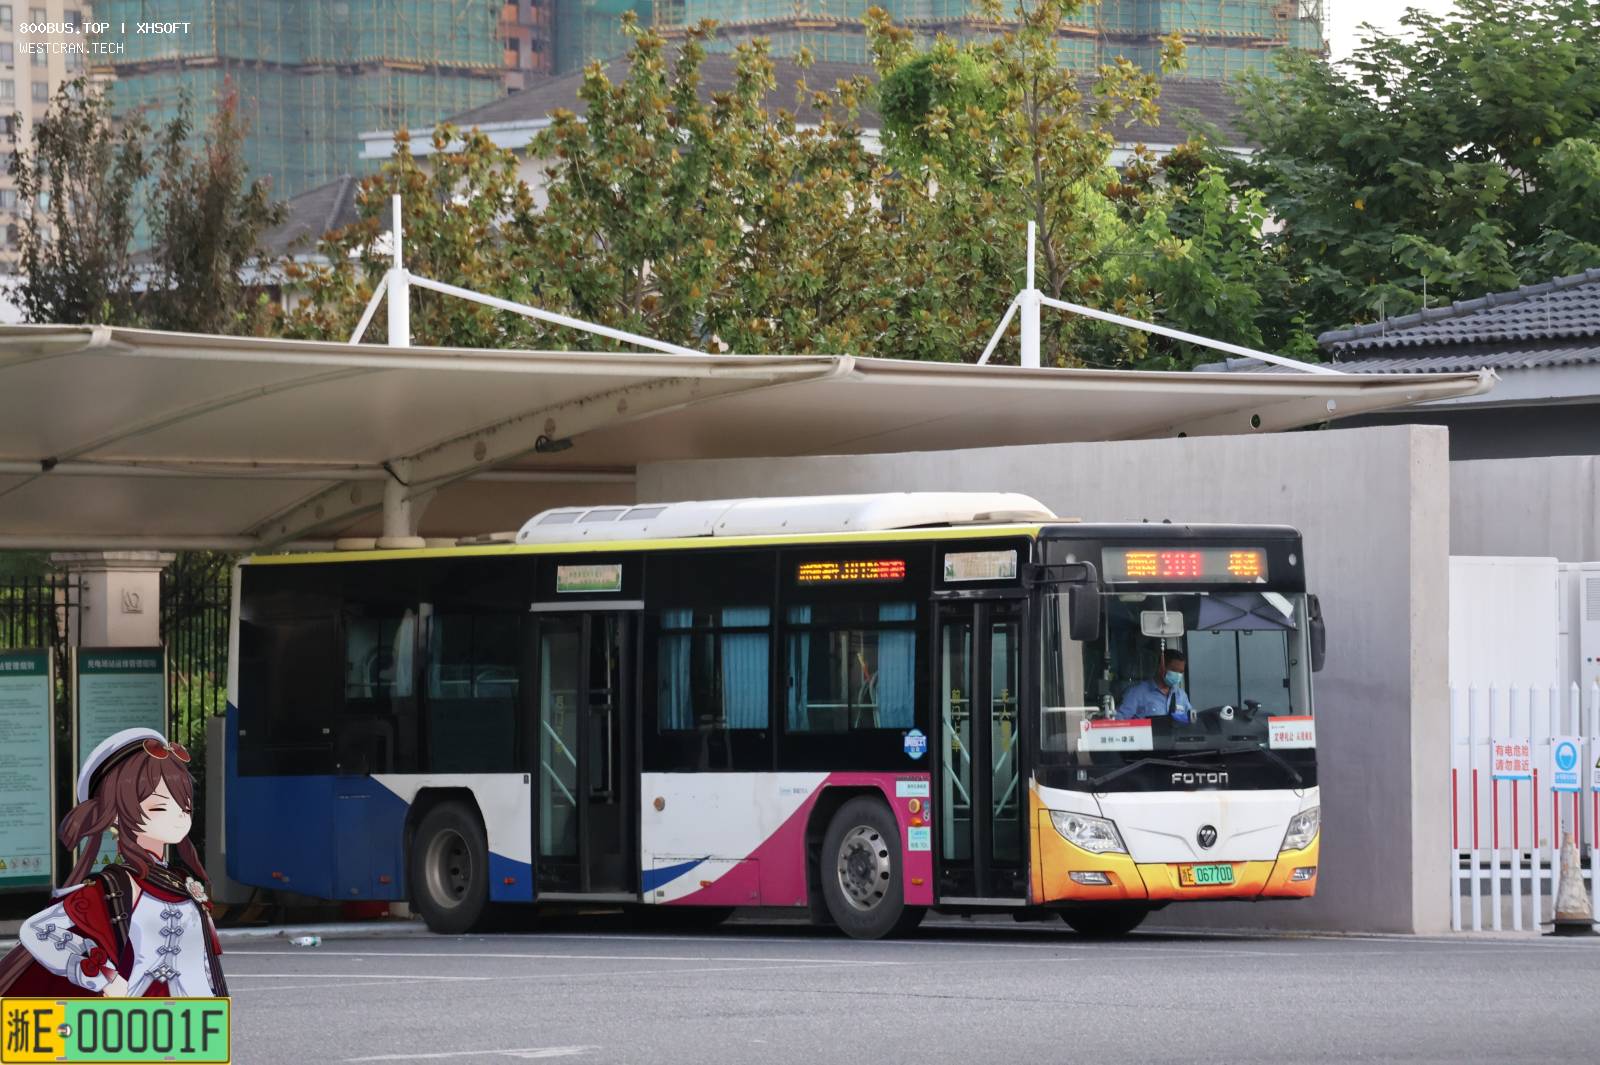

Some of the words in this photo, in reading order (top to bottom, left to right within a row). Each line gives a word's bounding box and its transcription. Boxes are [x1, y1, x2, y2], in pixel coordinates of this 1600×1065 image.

[1495, 744, 1529, 757] 有电危险
[1495, 759, 1530, 771] 请勿靠近
[1171, 772, 1229, 785] FOTON
